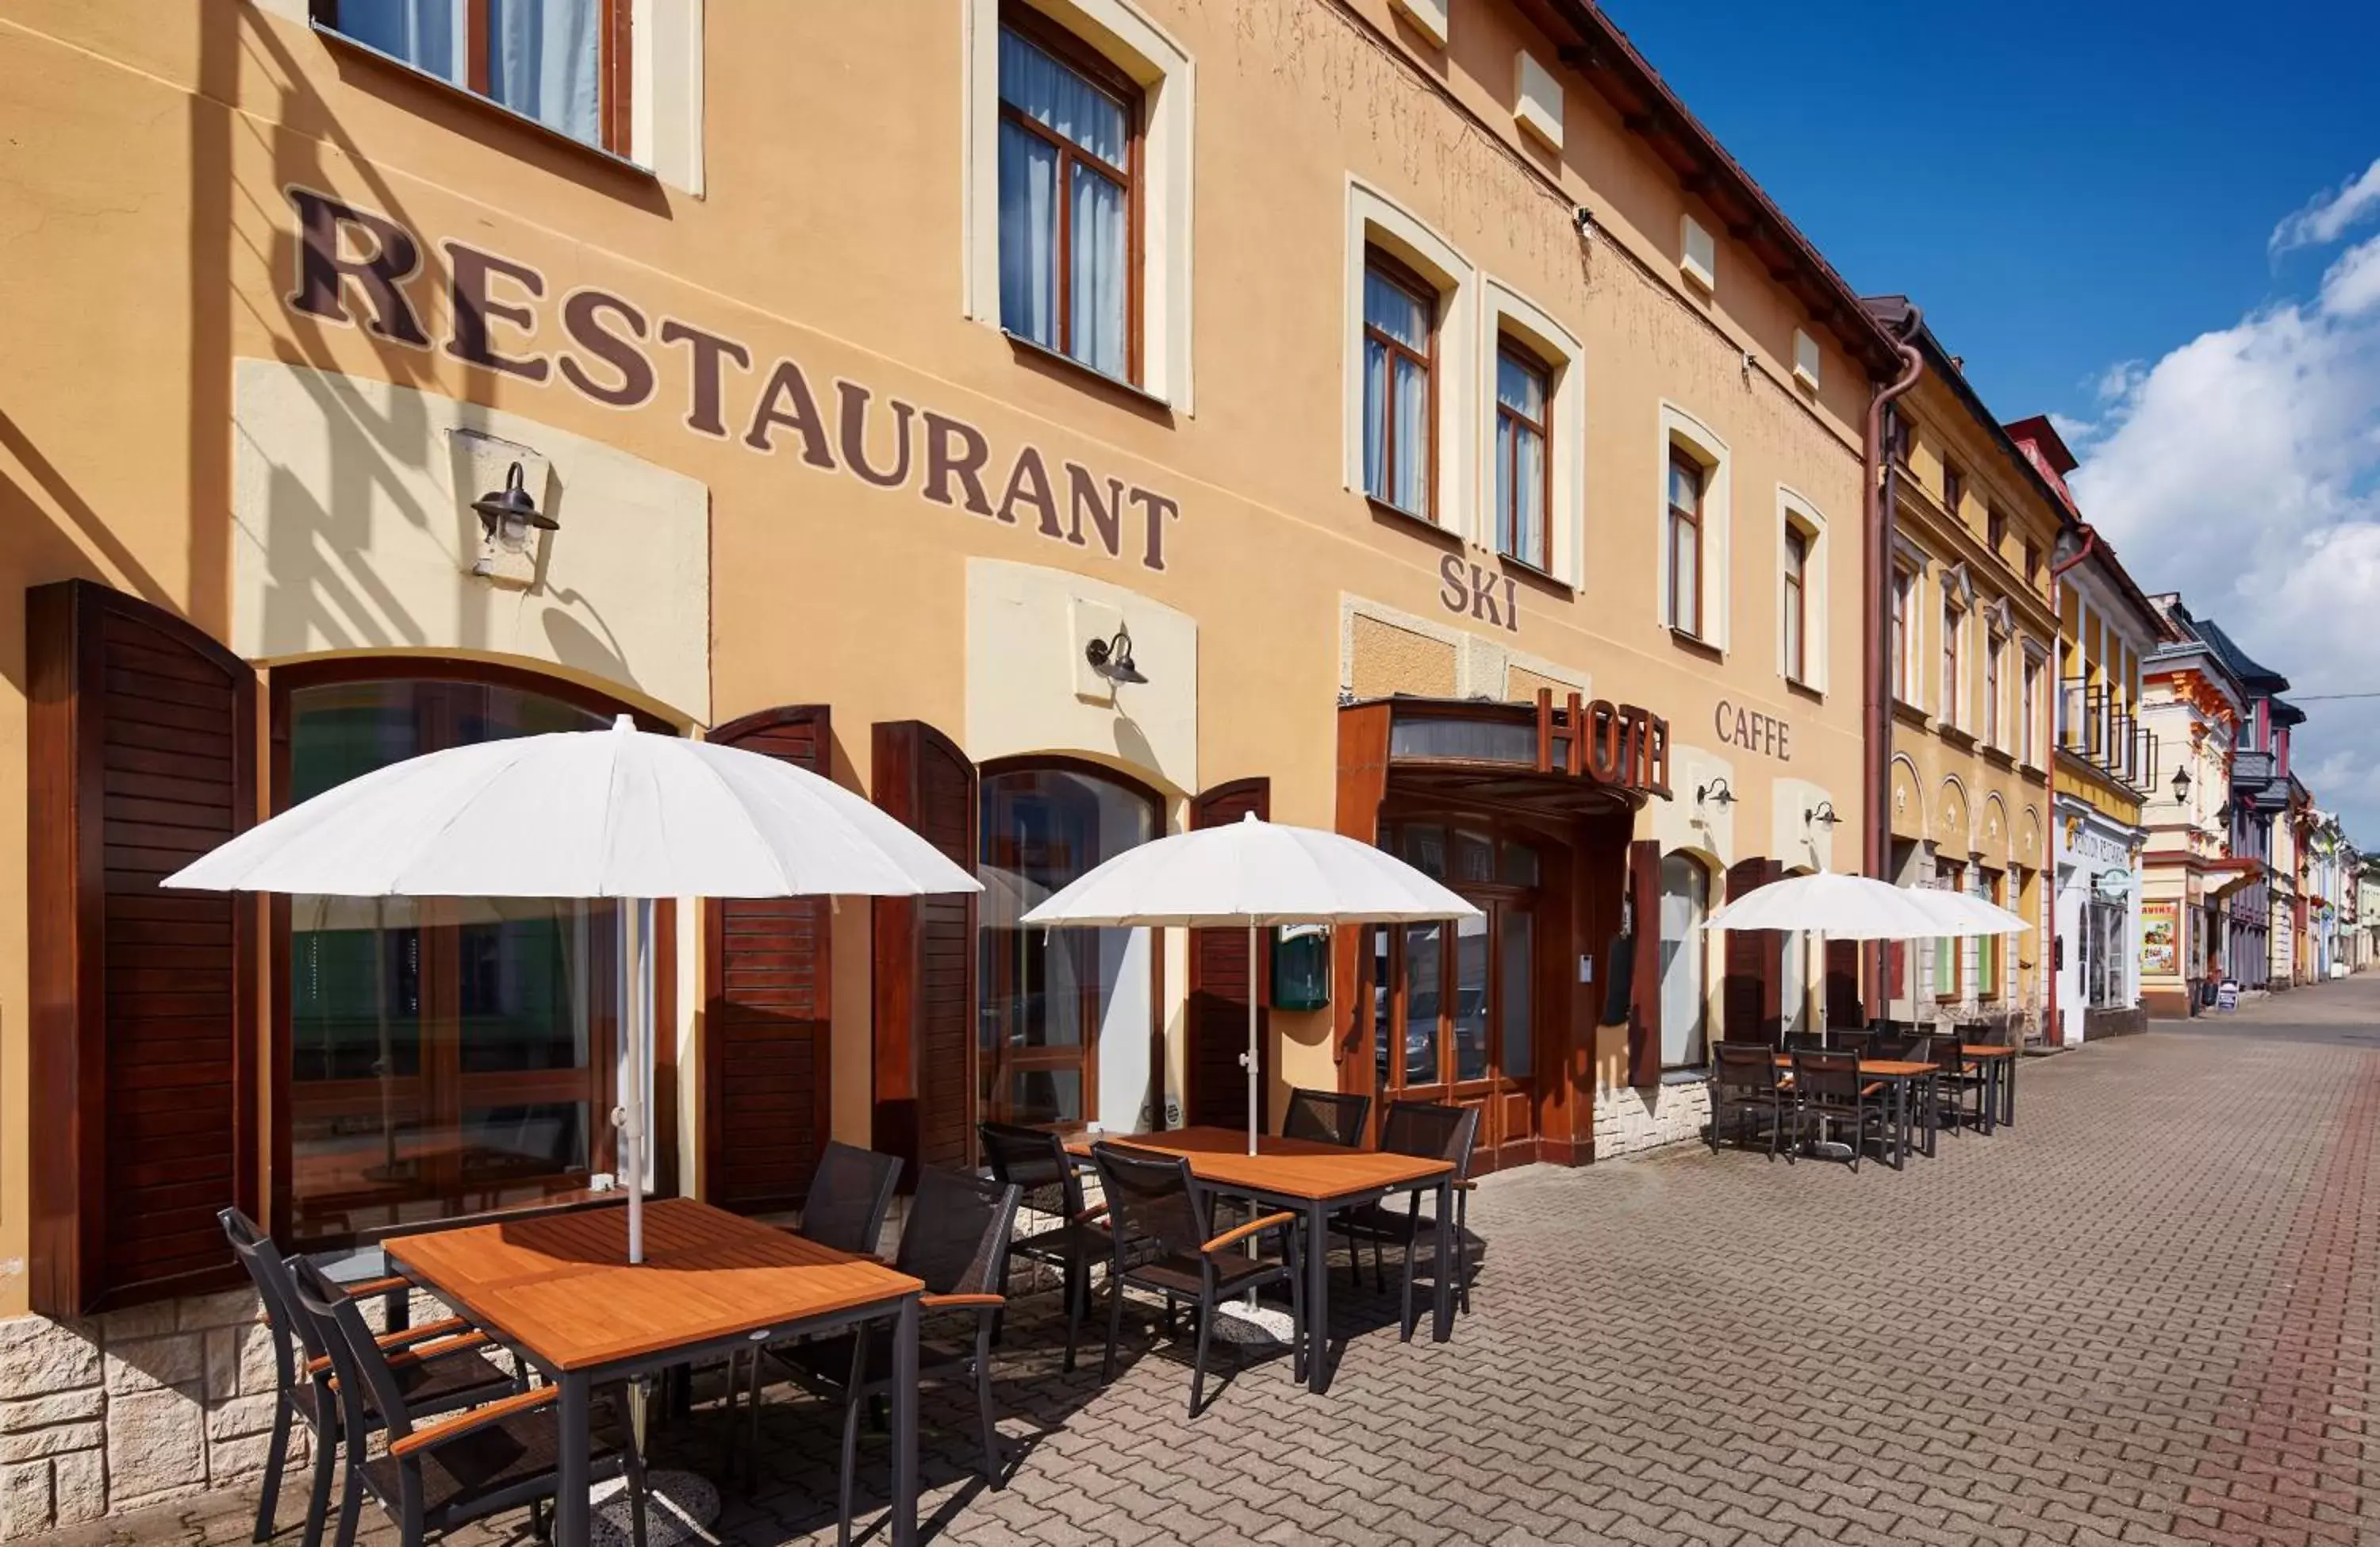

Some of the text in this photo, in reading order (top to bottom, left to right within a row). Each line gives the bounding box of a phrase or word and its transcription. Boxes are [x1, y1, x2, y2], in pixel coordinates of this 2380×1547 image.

[286, 187, 1179, 570] RESTAURANT
[1441, 555, 1518, 632] SKI
[1715, 700, 1790, 762] CAFFE
